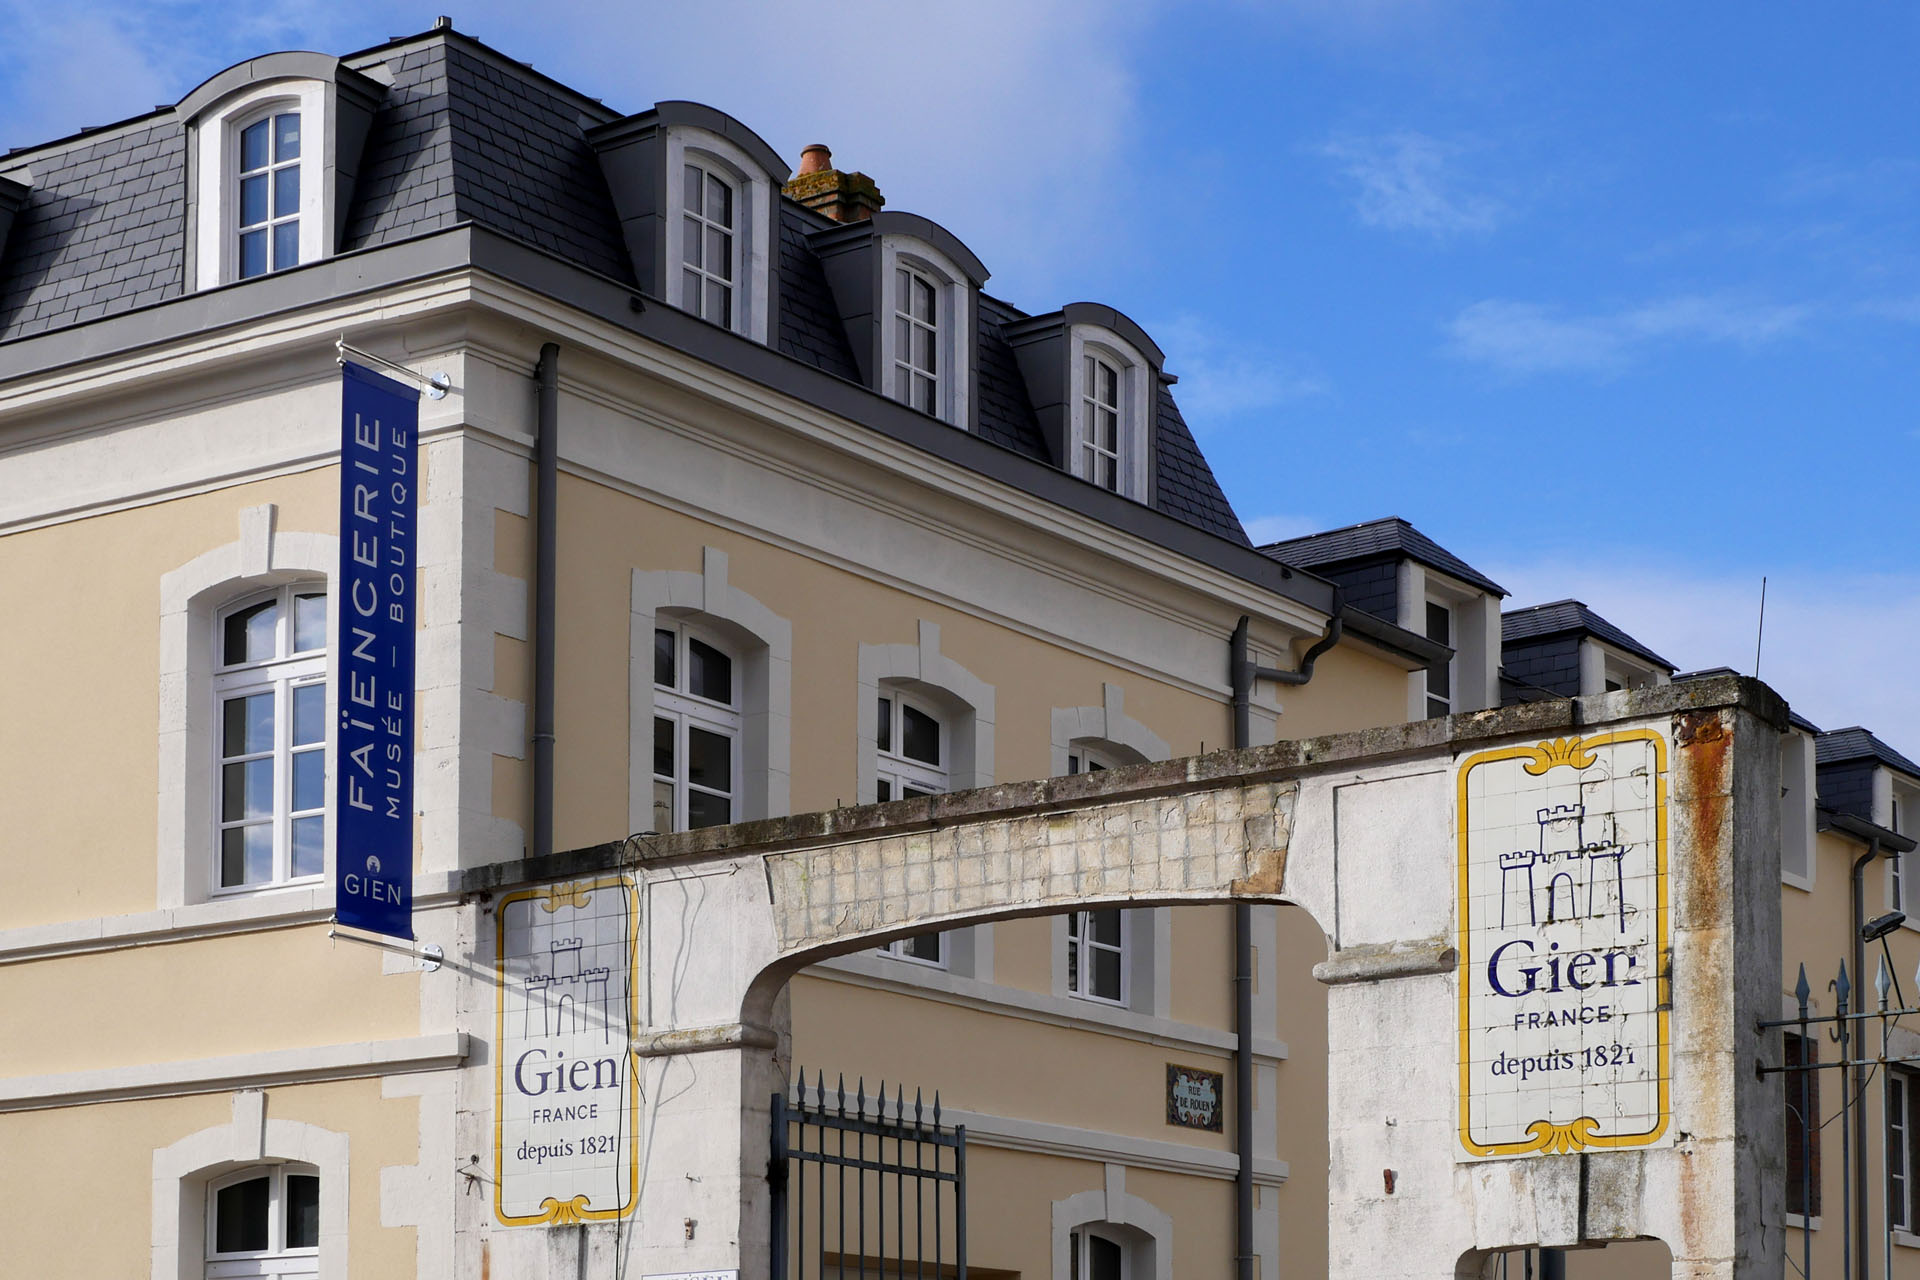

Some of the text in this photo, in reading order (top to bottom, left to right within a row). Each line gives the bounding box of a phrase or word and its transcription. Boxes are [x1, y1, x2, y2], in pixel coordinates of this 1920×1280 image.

[389, 427, 407, 624] BOUTIQUE
[341, 413, 380, 812] FAÏENCERIE
[381, 690, 402, 819] MUSÉE
[344, 873, 402, 906] GIEN
[1487, 939, 1642, 998] Gien
[1514, 1005, 1610, 1032] FRANCE
[514, 1048, 620, 1097] Gien
[1491, 1043, 1636, 1081] depuis 1821
[1179, 1096, 1211, 1112] DE ROUEN
[1188, 1085, 1202, 1097] RUE
[532, 1103, 598, 1125] FRANCE
[516, 1135, 616, 1165] depuis 1821
